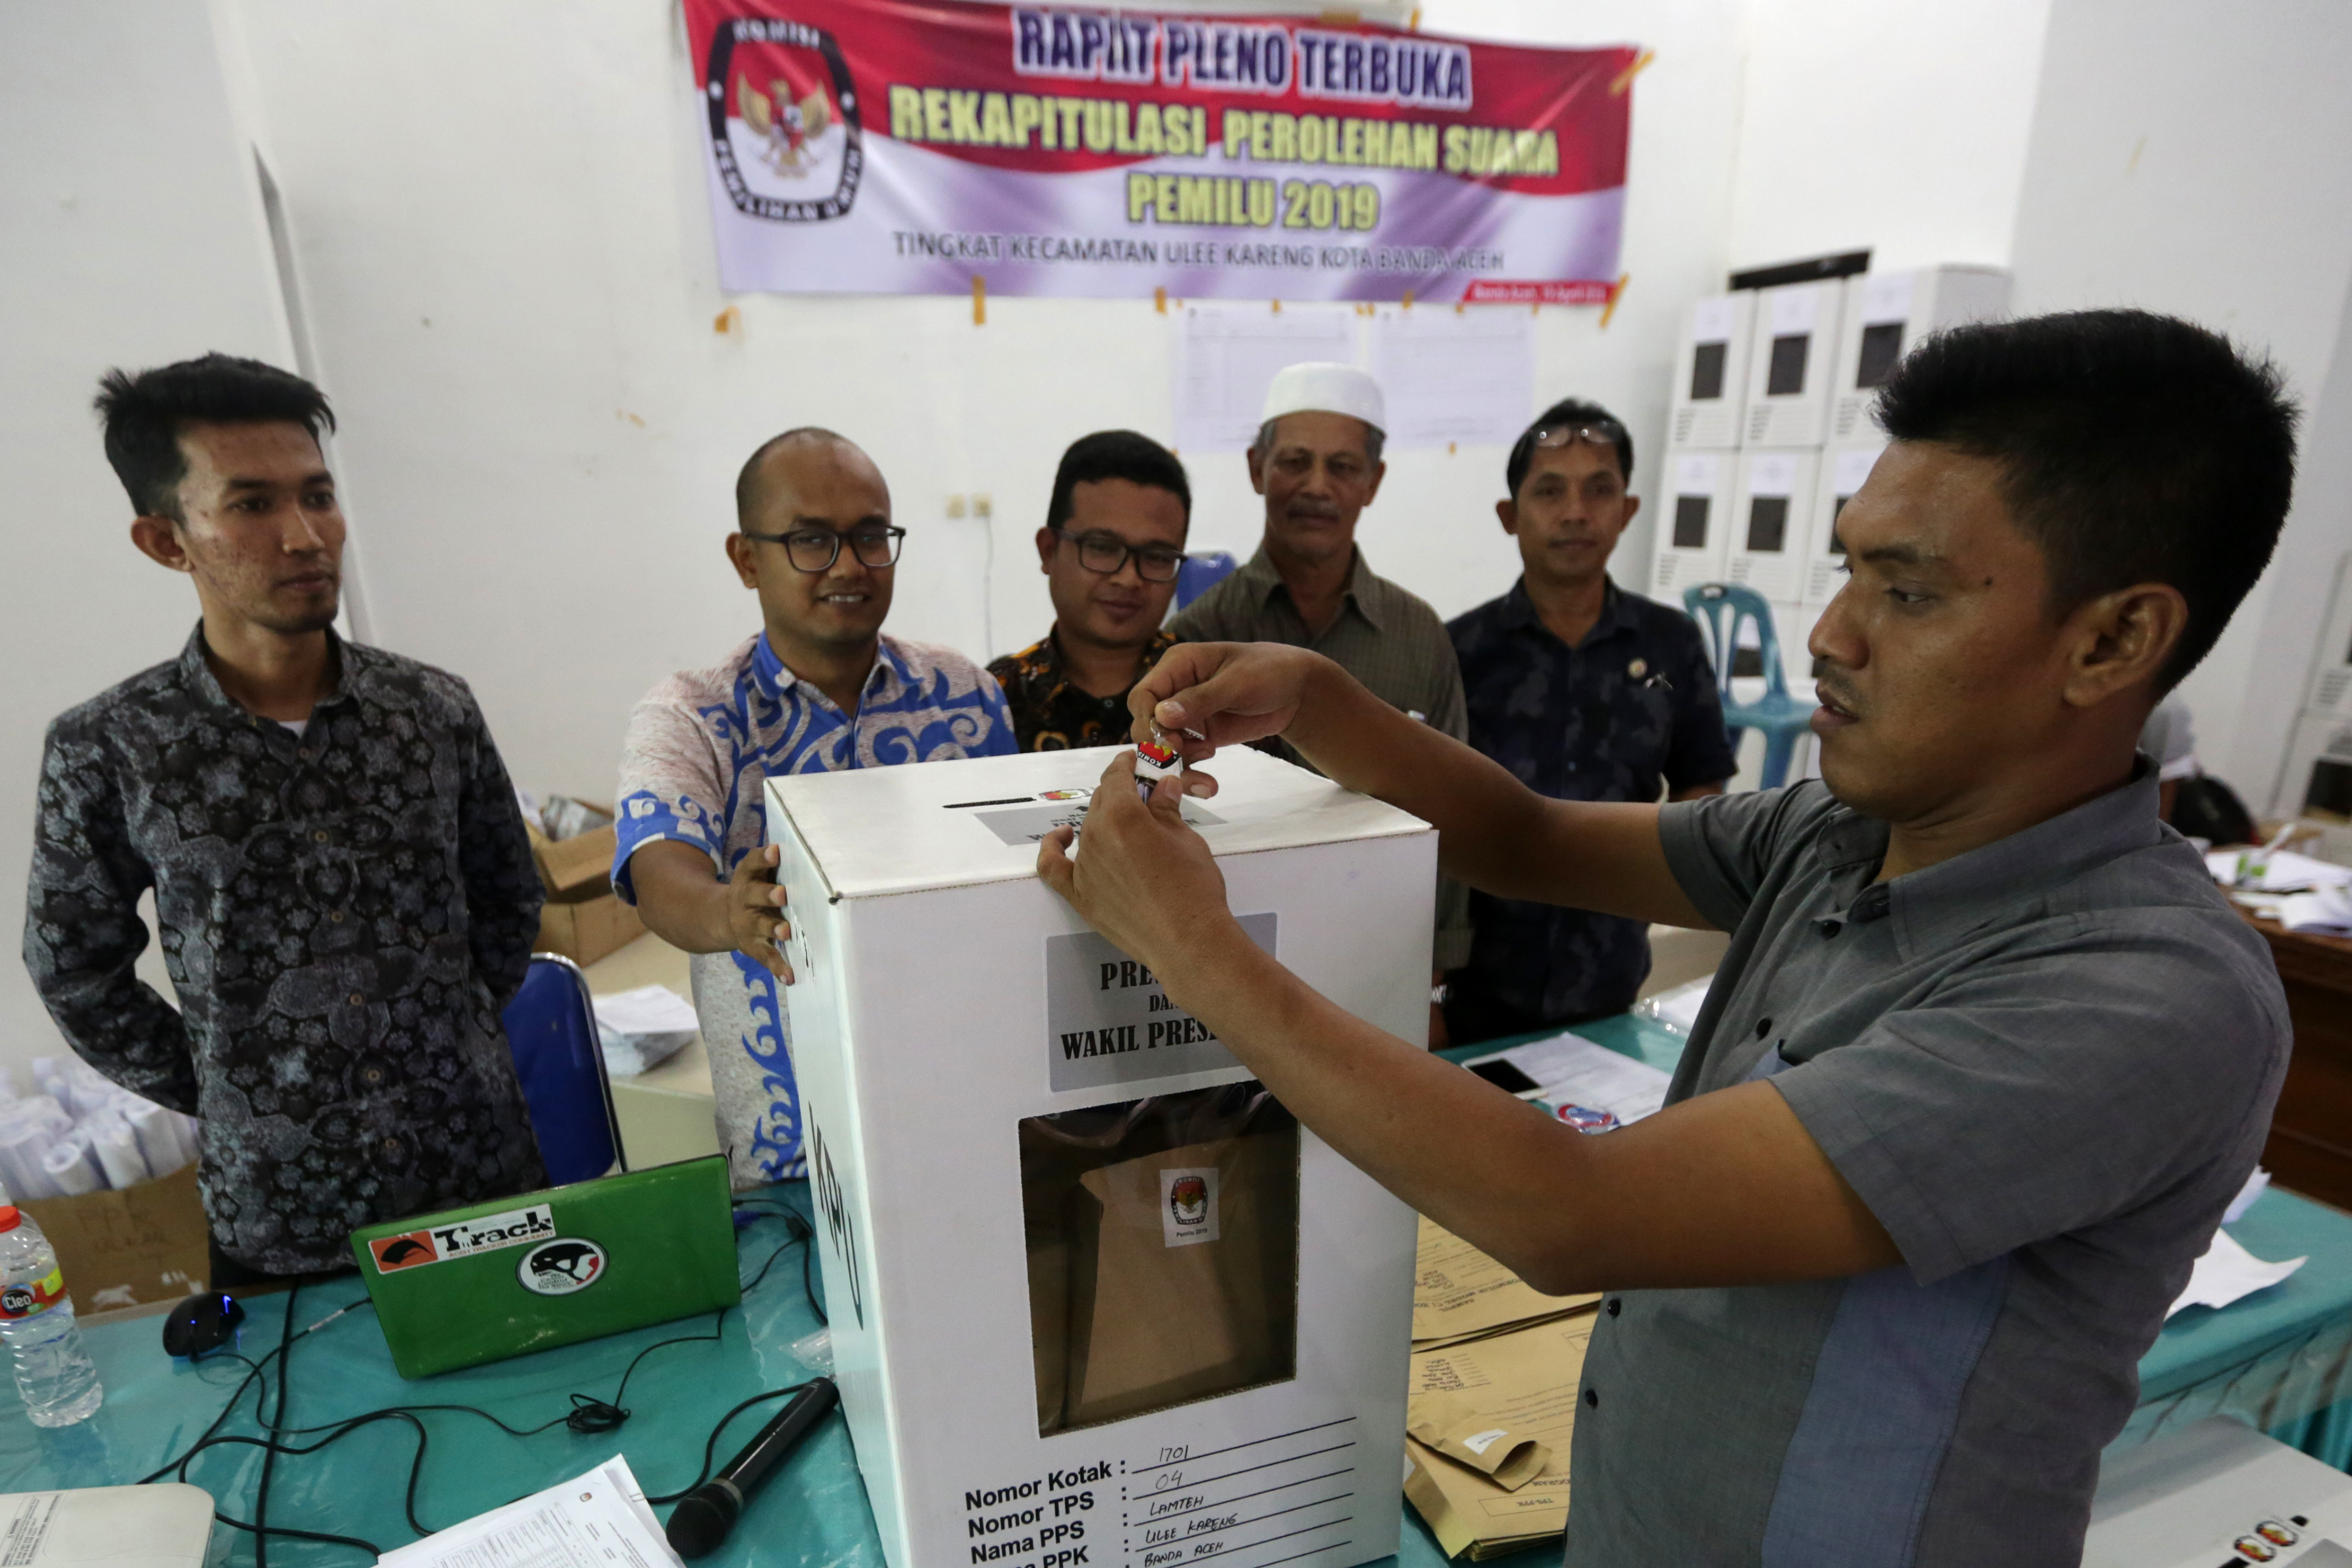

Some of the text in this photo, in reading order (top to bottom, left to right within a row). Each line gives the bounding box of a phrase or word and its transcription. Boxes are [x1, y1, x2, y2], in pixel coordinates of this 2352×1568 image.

[731, 18, 821, 49] KOMISI
[1163, 21, 1289, 88] PLENO
[1297, 35, 1470, 103] TERBUKA
[888, 84, 1559, 176] REKAPITULASI PEROLEHAN SUARA
[1127, 173, 1380, 232] PEMILU 2019
[894, 231, 1001, 259] TINGKAT
[1010, 236, 1157, 264] KECAMATAN
[1165, 242, 1217, 266] ULEE
[1225, 243, 1314, 270] KARENG
[1320, 245, 1374, 270] KOTA
[1100, 961, 1159, 991] PRE
[1061, 1025, 1140, 1060] WAKIL
[434, 1211, 553, 1252] Track
[5, 1295, 32, 1309] Cleo
[1160, 1444, 1188, 1462] 1701
[965, 1460, 1112, 1511] Nomor Kotak
[1155, 1470, 1182, 1490] 04
[968, 1491, 1094, 1538] Nomor TPS
[1150, 1496, 1204, 1516] LAMTEH
[971, 1520, 1085, 1564] Nama PPS
[1146, 1513, 1238, 1544] ULEE KARENG
[1043, 1545, 1089, 1568] PPK
[1145, 1542, 1224, 1568] BANDA ACEH
